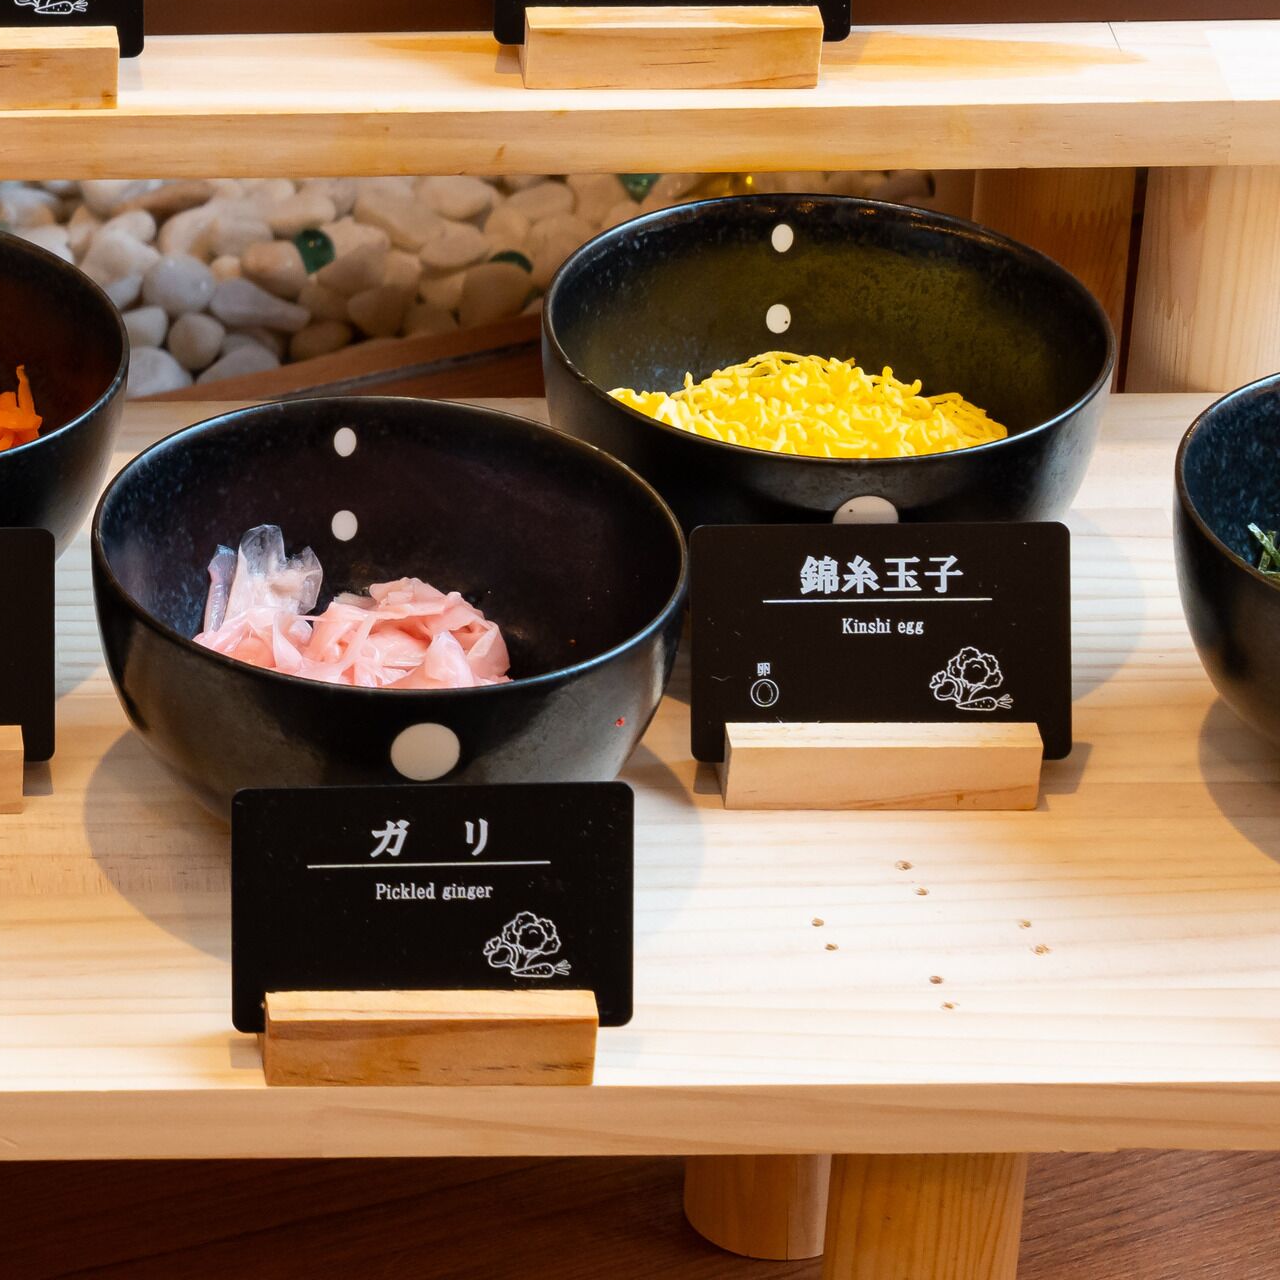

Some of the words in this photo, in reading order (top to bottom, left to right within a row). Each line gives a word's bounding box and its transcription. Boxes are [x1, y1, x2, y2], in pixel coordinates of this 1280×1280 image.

[800, 555, 965, 596] 錦糸玉子
[842, 618, 893, 636] Kinshi
[898, 622, 926, 637] egg
[757, 663, 772, 678] 卵
[376, 882, 437, 901] Pickled
[442, 884, 495, 902] ginger
